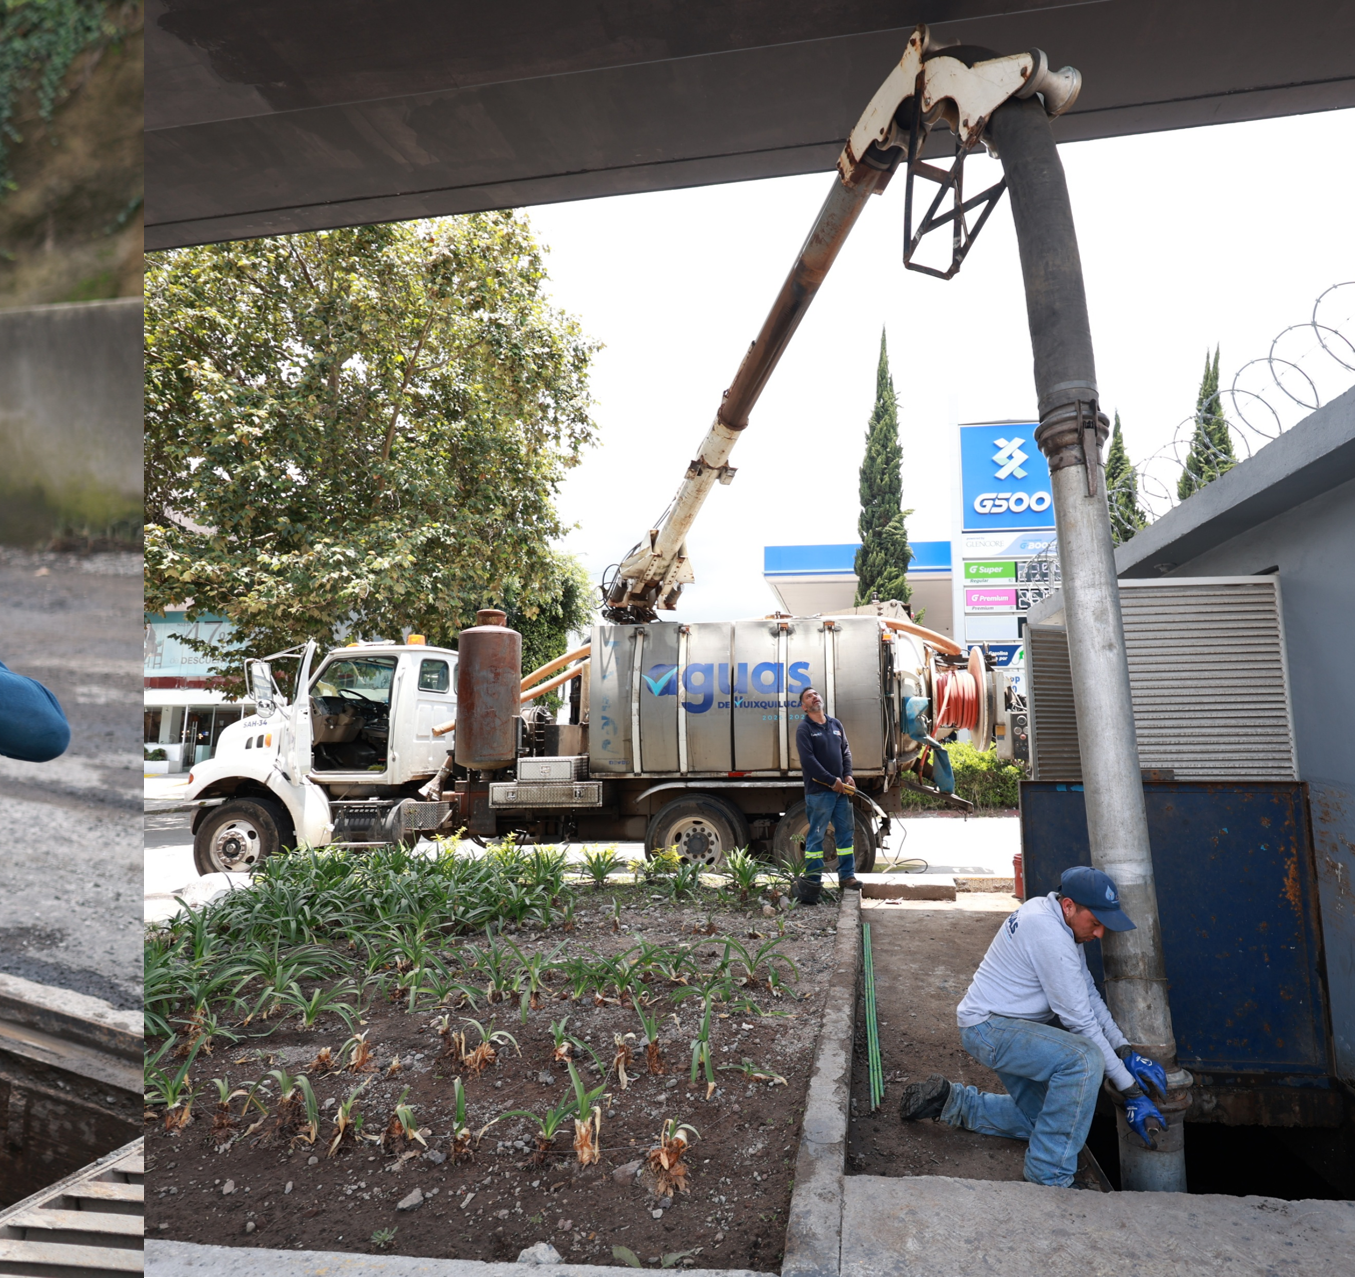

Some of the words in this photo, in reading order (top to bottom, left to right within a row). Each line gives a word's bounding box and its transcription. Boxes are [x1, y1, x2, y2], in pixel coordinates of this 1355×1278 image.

[973, 491, 1052, 515] G500
[965, 540, 1005, 548] GLENCORE
[978, 565, 1004, 575] Super
[646, 661, 812, 714] aguas
[717, 701, 731, 709] DE
[733, 696, 803, 709] HUIXQUILUCA
